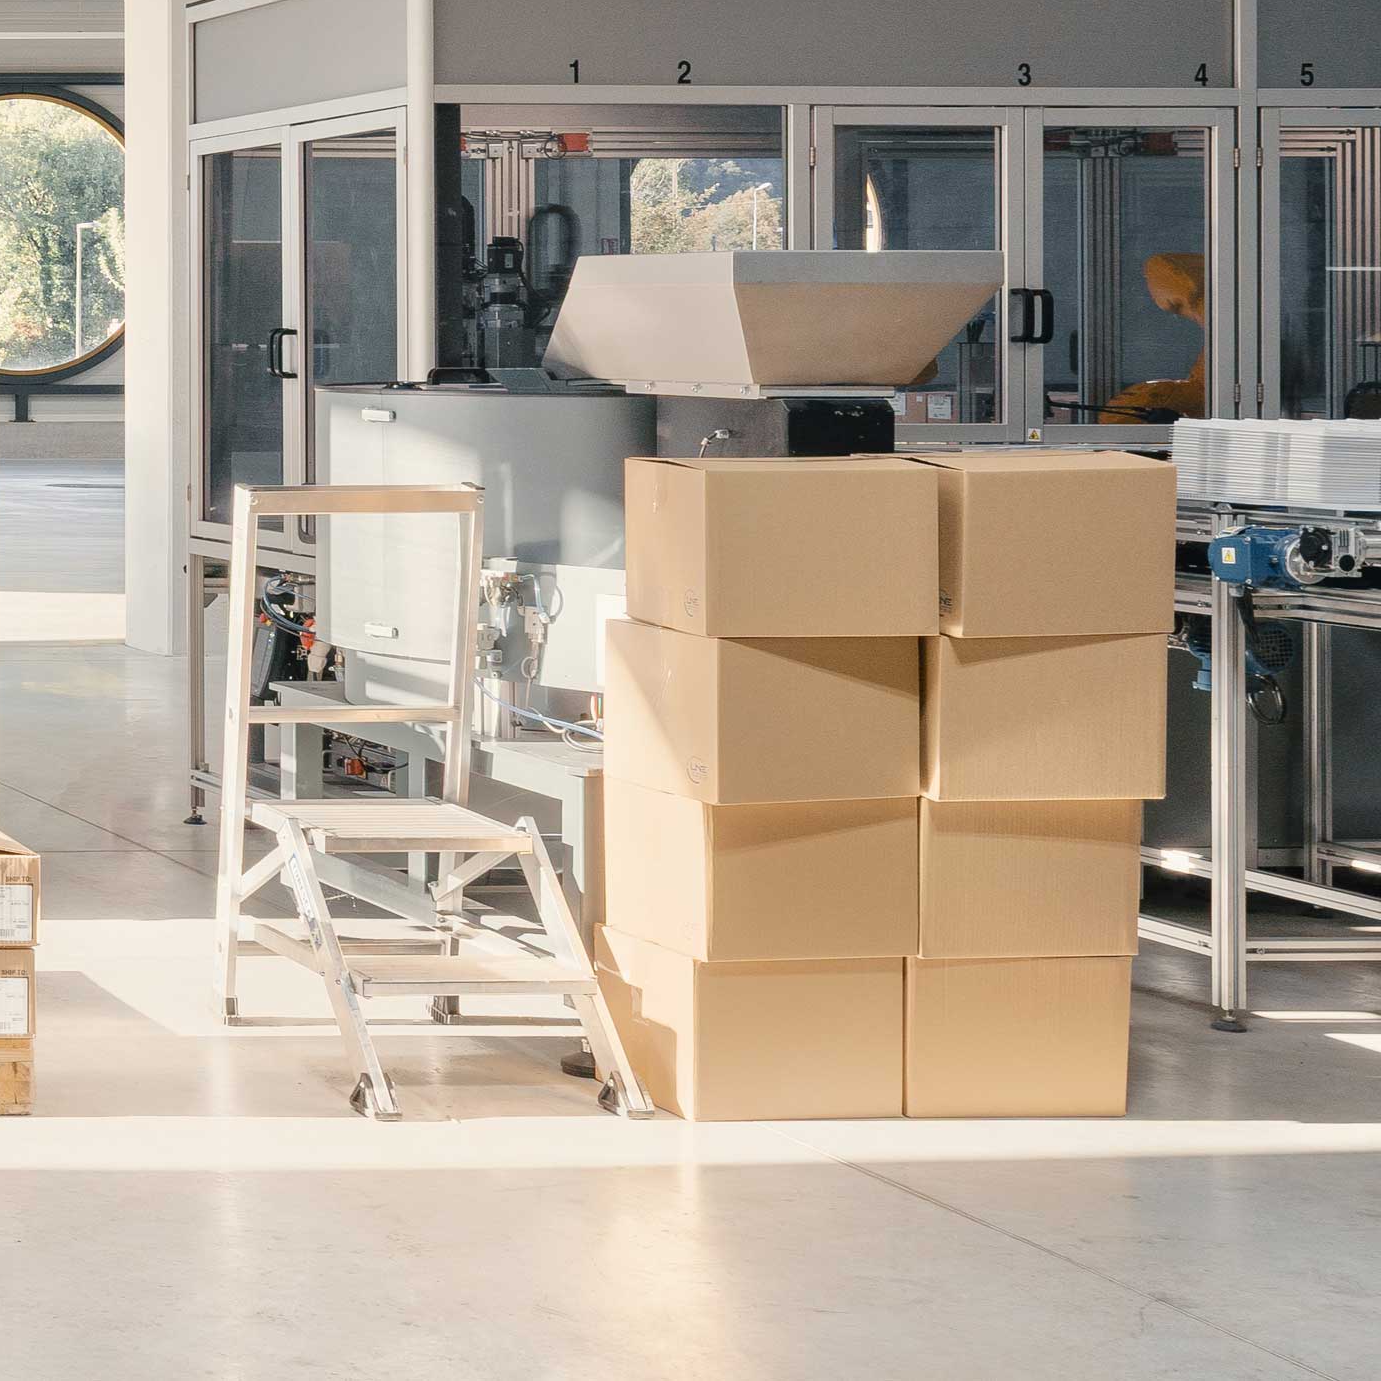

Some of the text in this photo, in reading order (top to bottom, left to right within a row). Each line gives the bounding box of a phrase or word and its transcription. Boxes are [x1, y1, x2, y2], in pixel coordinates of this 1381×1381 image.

[569, 60, 1314, 87] 1 2 3 4 5
